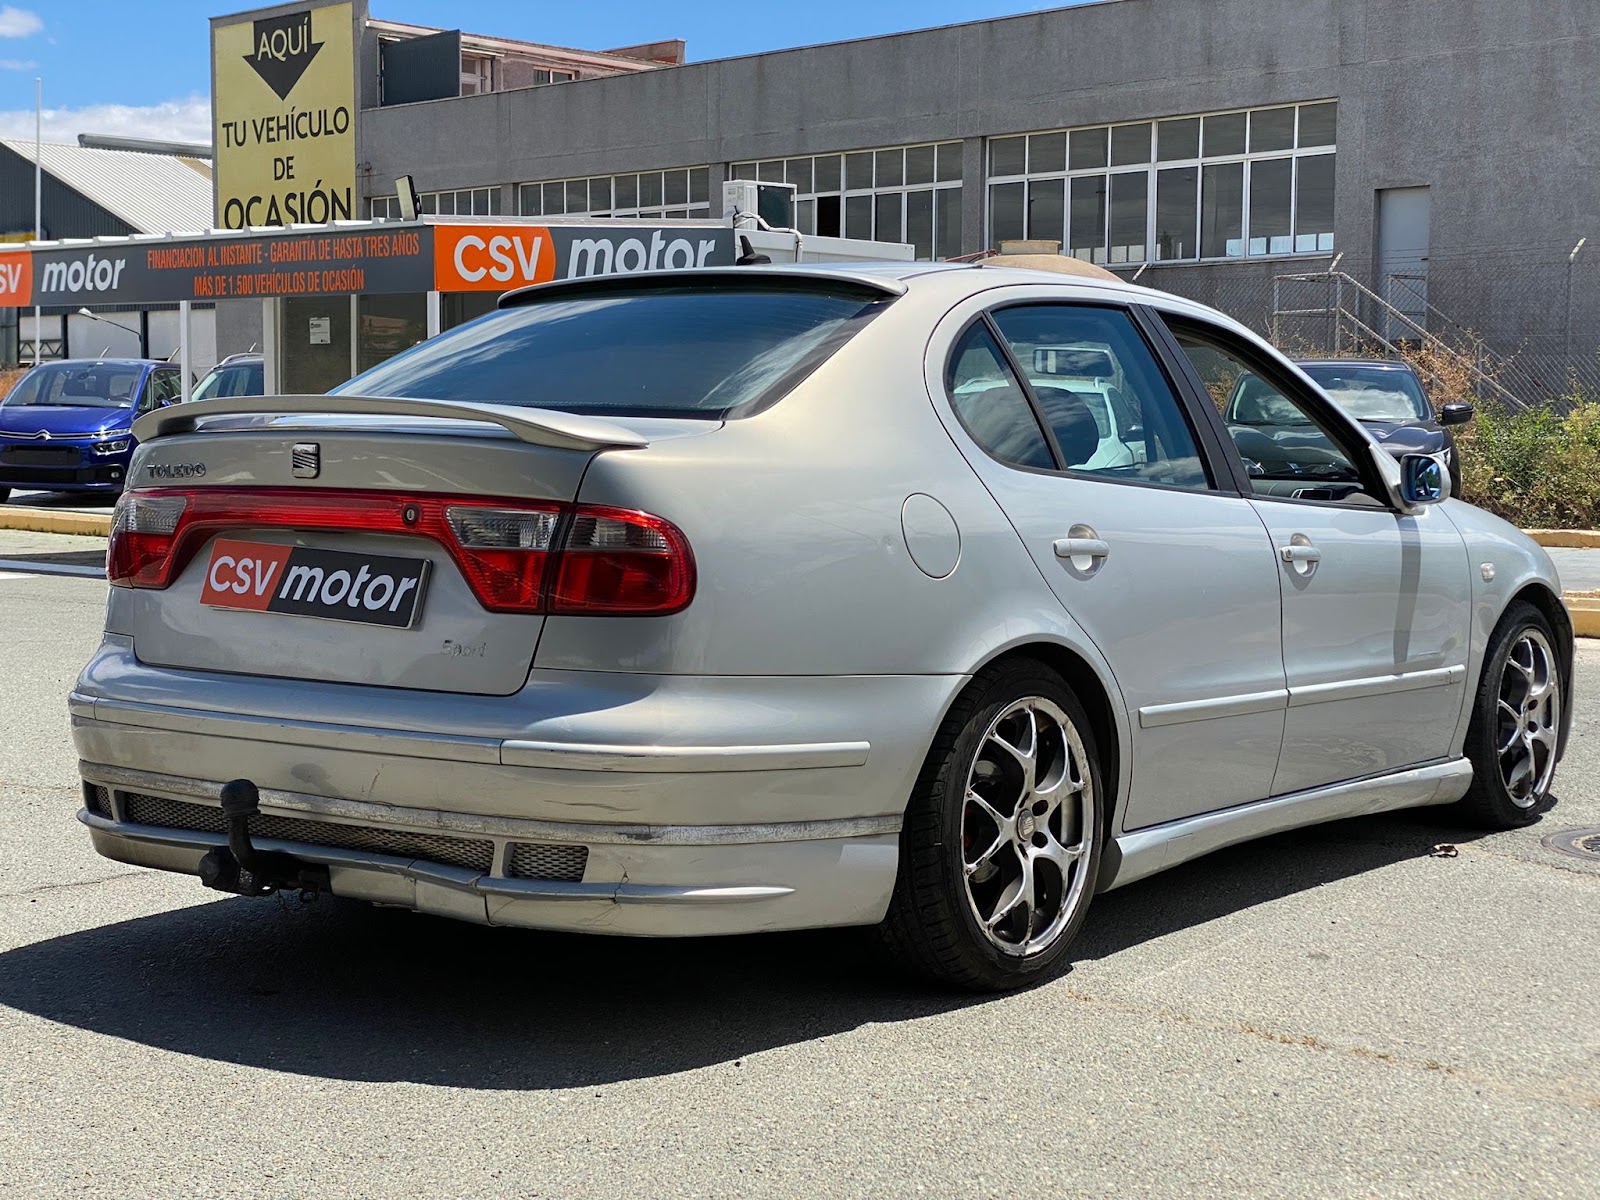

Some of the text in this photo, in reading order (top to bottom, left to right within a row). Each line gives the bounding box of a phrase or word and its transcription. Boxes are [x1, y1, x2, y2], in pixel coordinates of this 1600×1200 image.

[257, 17, 309, 62] AQUÍ
[222, 106, 350, 148] TU VEHÍCULO
[273, 156, 295, 181] DE
[224, 179, 351, 229] OCASIÓN
[207, 246, 219, 267] AL
[220, 243, 262, 267] INSTANTE
[270, 235, 317, 263] GARANTÍA
[318, 239, 331, 260] DE
[333, 236, 363, 260] HASTA
[364, 233, 390, 257] TRES
[391, 230, 420, 256] AÑOS
[453, 229, 716, 282] CSV motor
[41, 253, 126, 293] motor
[194, 264, 365, 296] MÁS DE 1.500 VEHÍCULOS DE OCASIÓN
[146, 462, 207, 479] TOLEDO
[209, 555, 418, 612] CSV motor
